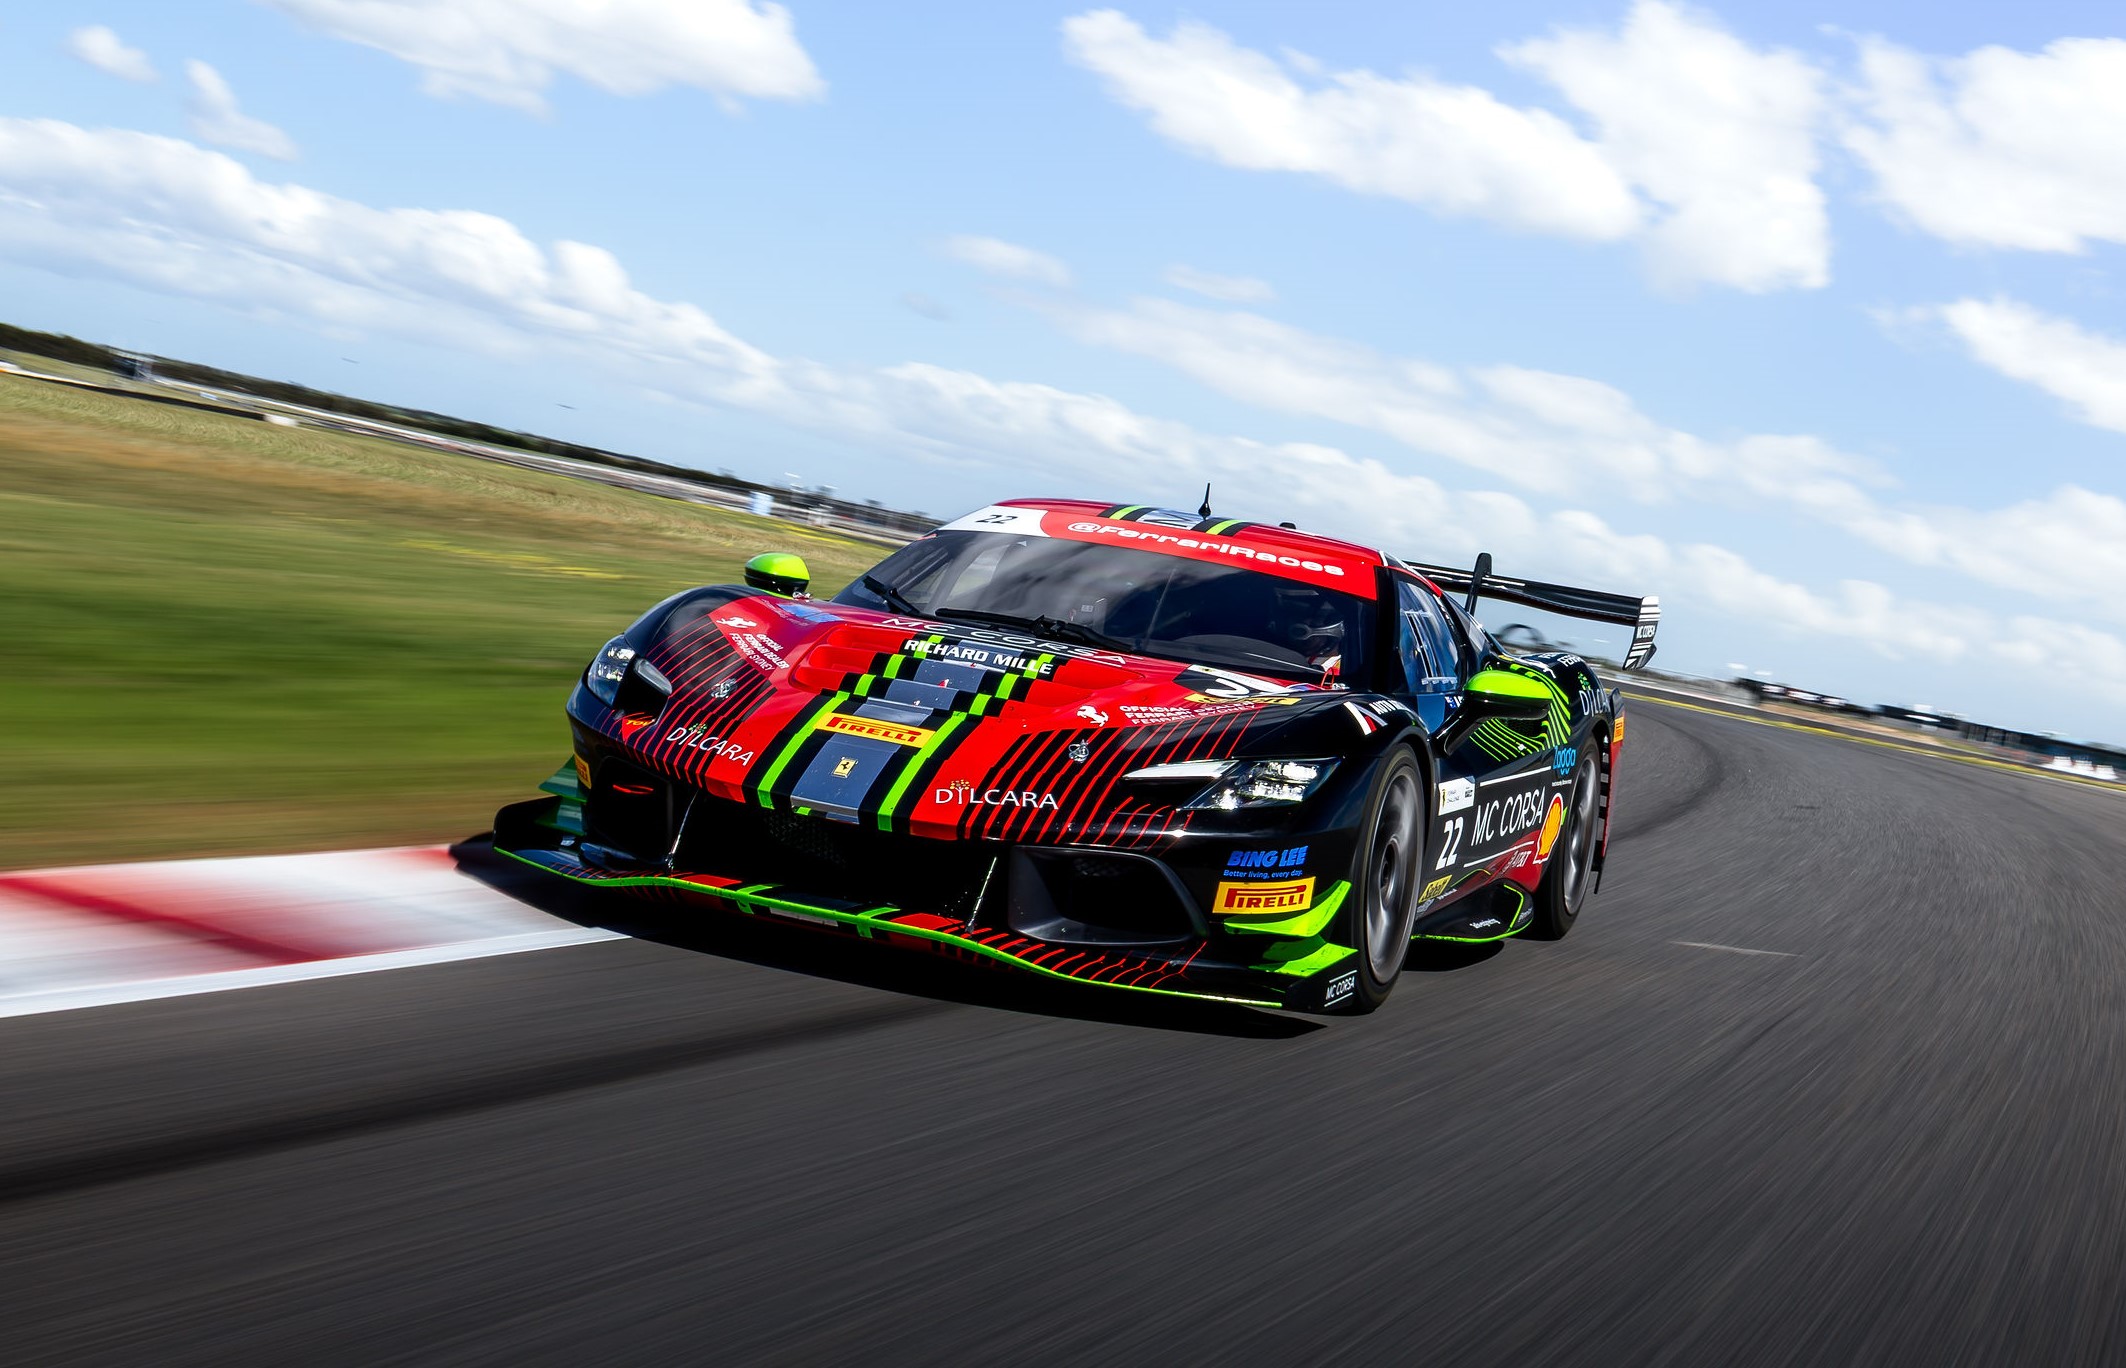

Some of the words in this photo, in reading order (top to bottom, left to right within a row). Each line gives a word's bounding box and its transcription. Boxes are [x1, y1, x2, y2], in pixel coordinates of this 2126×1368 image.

[976, 514, 1018, 524] 22
[882, 617, 956, 634] MC
[971, 631, 1127, 664] CORSA
[904, 639, 988, 662] RICHARD
[993, 654, 1053, 675] MILLE
[1119, 705, 1190, 713] OFFICIAL
[826, 716, 922, 742] PIRELLI
[1471, 800, 1499, 846] MC
[1500, 786, 1546, 837] CORSA
[1435, 816, 1464, 871] 22
[1227, 850, 1279, 868] BING
[1279, 845, 1308, 867] LEE
[1223, 869, 1247, 878] Better
[1248, 870, 1270, 879] living,
[1271, 871, 1289, 879] every
[1224, 884, 1307, 908] PIRELLI
[1325, 984, 1336, 1000] MC
[1336, 975, 1355, 996] CORSA
